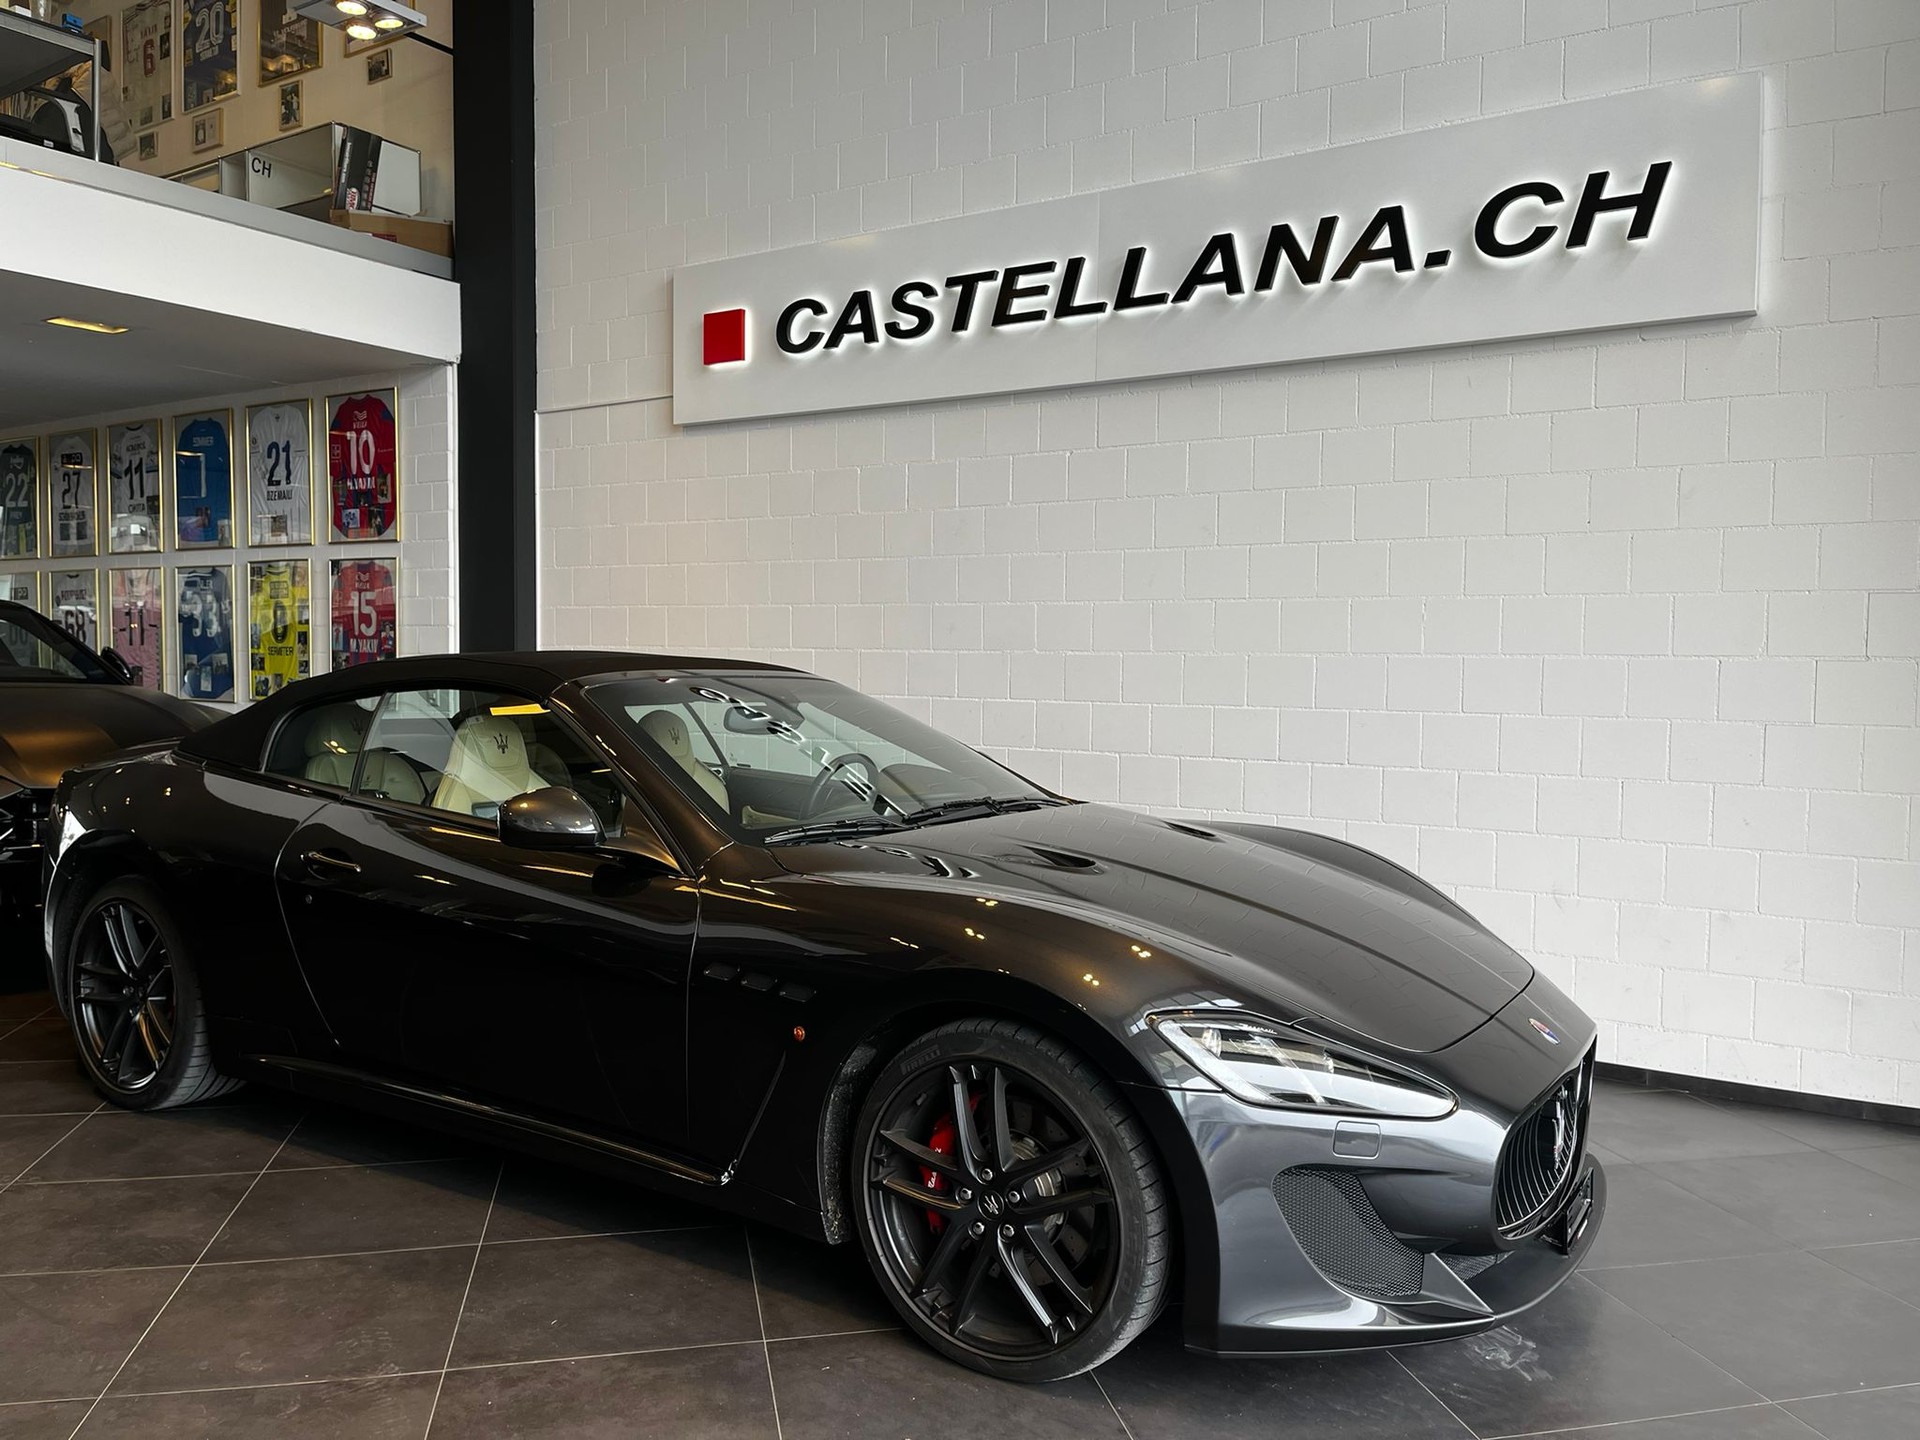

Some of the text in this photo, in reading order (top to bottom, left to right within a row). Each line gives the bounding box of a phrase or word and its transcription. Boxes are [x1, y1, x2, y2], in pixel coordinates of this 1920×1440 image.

[196, 2, 224, 53] 20
[251, 157, 272, 178] CH
[775, 161, 1673, 355] CASTELLANA.CH
[267, 440, 292, 487] 21
[346, 430, 376, 475] 10
[6, 473, 28, 507] 22
[62, 470, 81, 509] 27
[124, 457, 145, 500] 11
[351, 591, 377, 637] 15
